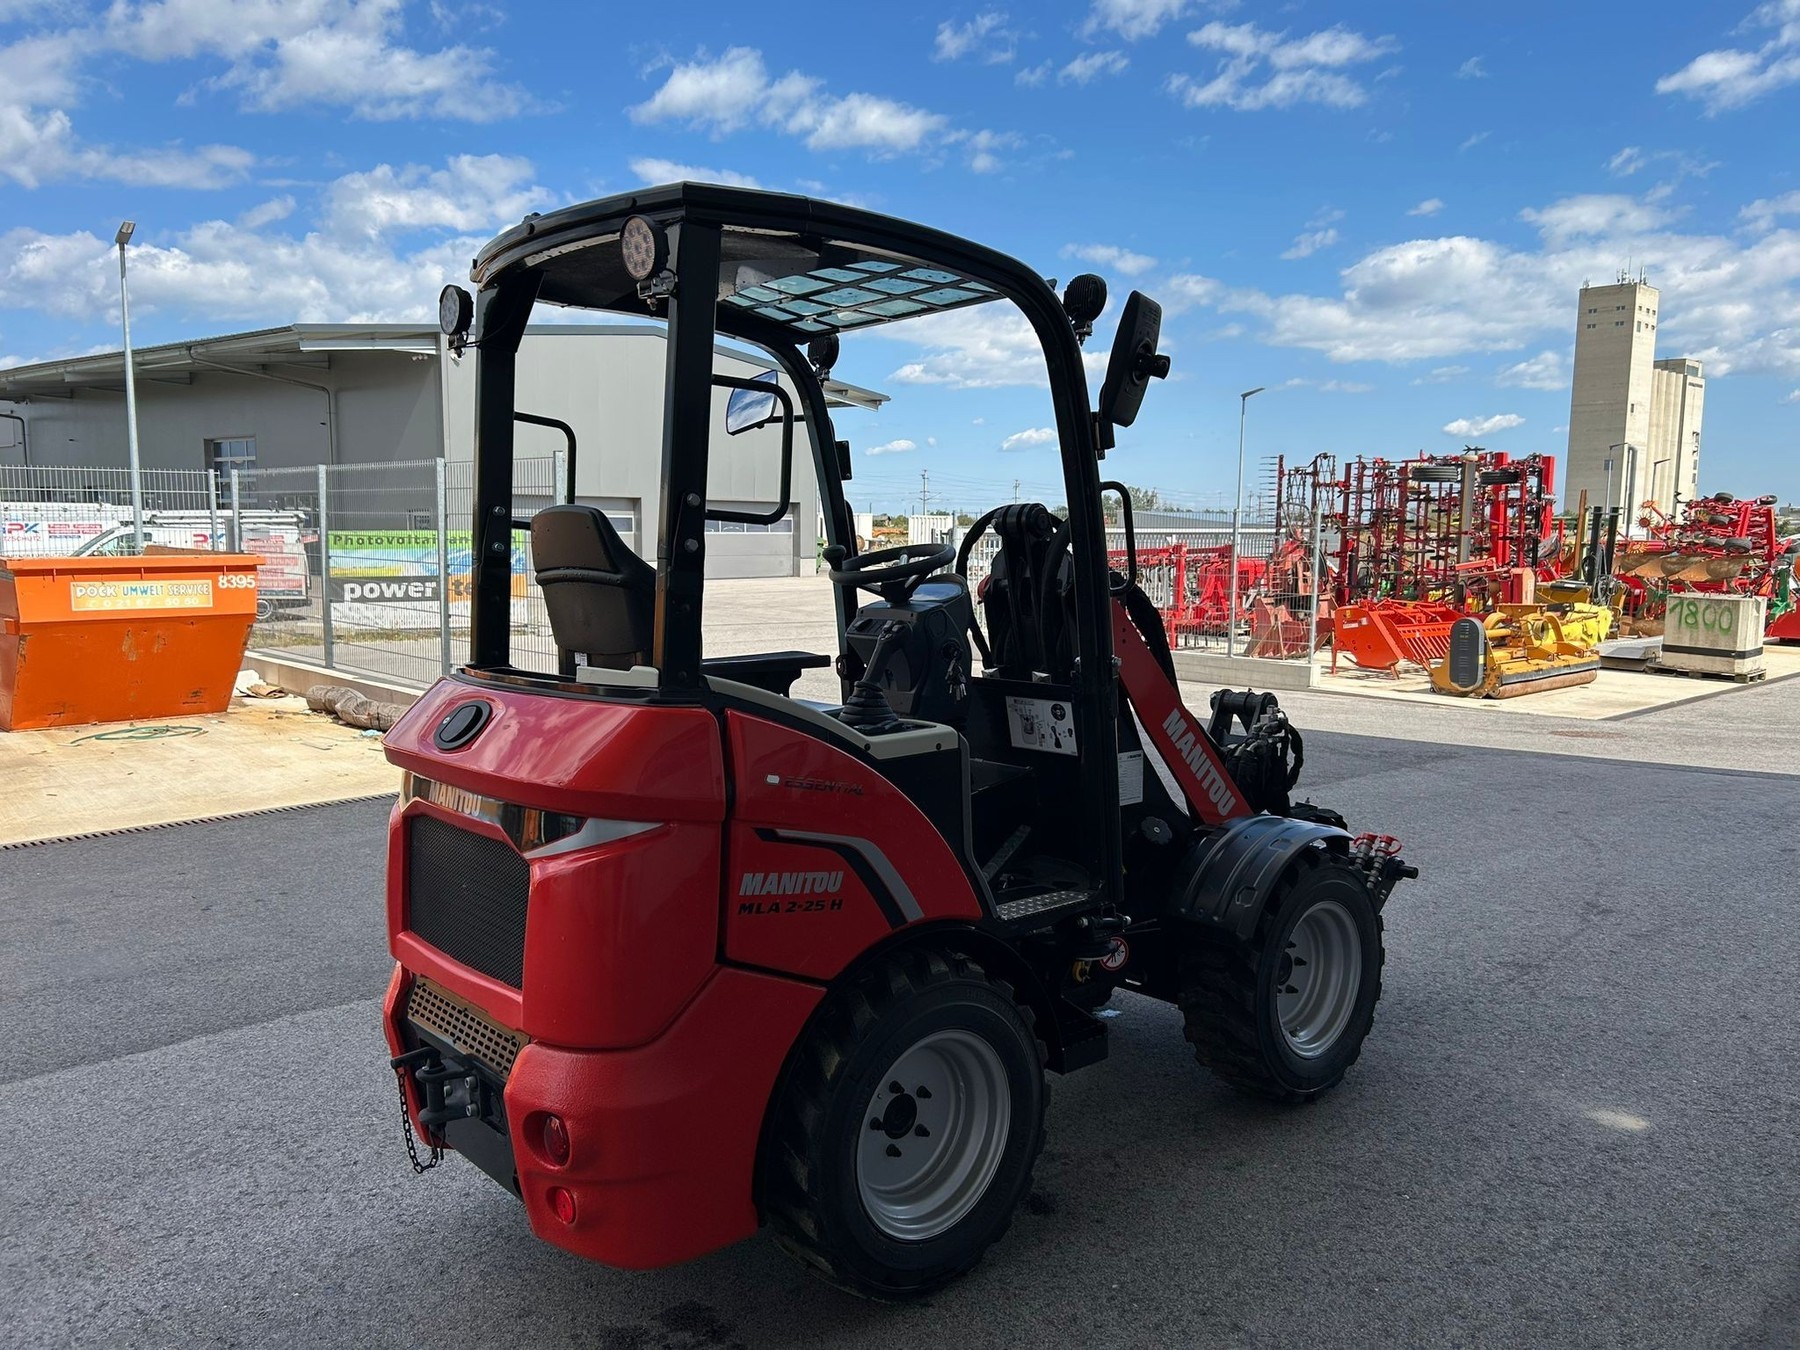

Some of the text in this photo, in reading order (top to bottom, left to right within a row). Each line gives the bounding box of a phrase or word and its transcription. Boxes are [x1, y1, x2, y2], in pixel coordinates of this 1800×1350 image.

[123, 585, 163, 597] UMWELT
[167, 583, 210, 596] SERVICE
[218, 574, 256, 589] 8395
[343, 581, 437, 602] power
[1668, 600, 1733, 634] 1800
[1162, 708, 1236, 816] MANITOU
[428, 780, 482, 817] MANITOU
[738, 871, 844, 896] MANITOU
[738, 899, 843, 915] MLA 2-25 H
